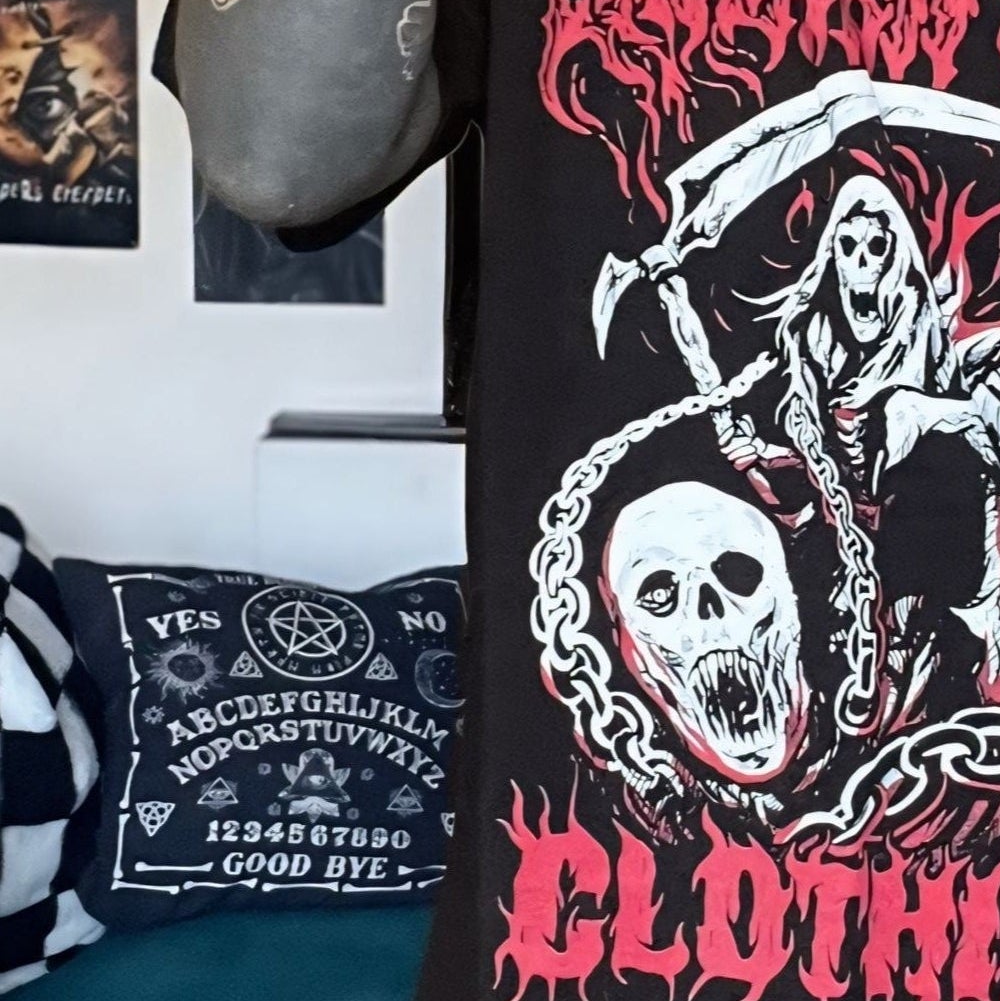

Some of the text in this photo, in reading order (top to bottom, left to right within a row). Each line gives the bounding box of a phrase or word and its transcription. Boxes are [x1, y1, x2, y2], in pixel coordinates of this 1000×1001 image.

[146, 609, 223, 640] YES
[397, 610, 447, 634] NO
[166, 690, 450, 752] ABCDEFGHIJKLM
[167, 718, 446, 789] NOPQRSTUVWXYZ
[206, 820, 411, 850] 1234567890
[222, 851, 389, 880] GOOD BYE
